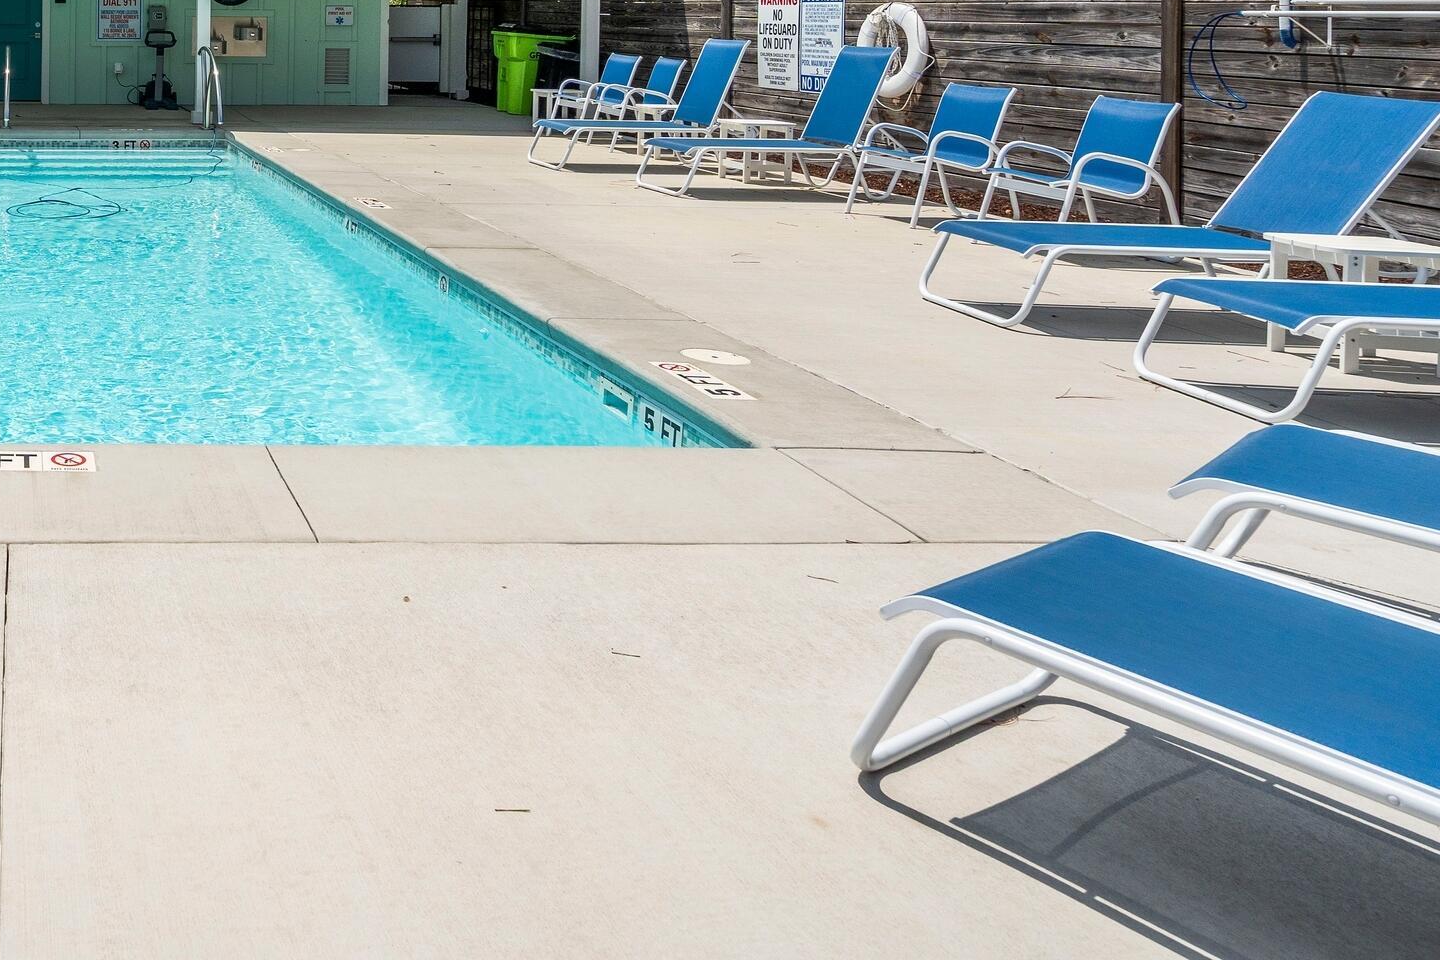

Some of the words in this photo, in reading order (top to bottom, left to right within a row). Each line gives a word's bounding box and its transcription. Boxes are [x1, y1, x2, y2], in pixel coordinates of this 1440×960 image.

[773, 9, 782, 21] NO
[759, 23, 797, 36] LIFEGUARD
[762, 37, 772, 49] ON
[774, 38, 792, 50] DUTY
[802, 76, 812, 90] NO
[112, 141, 119, 149] 3
[124, 141, 136, 150] FT
[677, 373, 723, 386] FT
[644, 407, 655, 432] 5
[661, 416, 681, 447] FT
